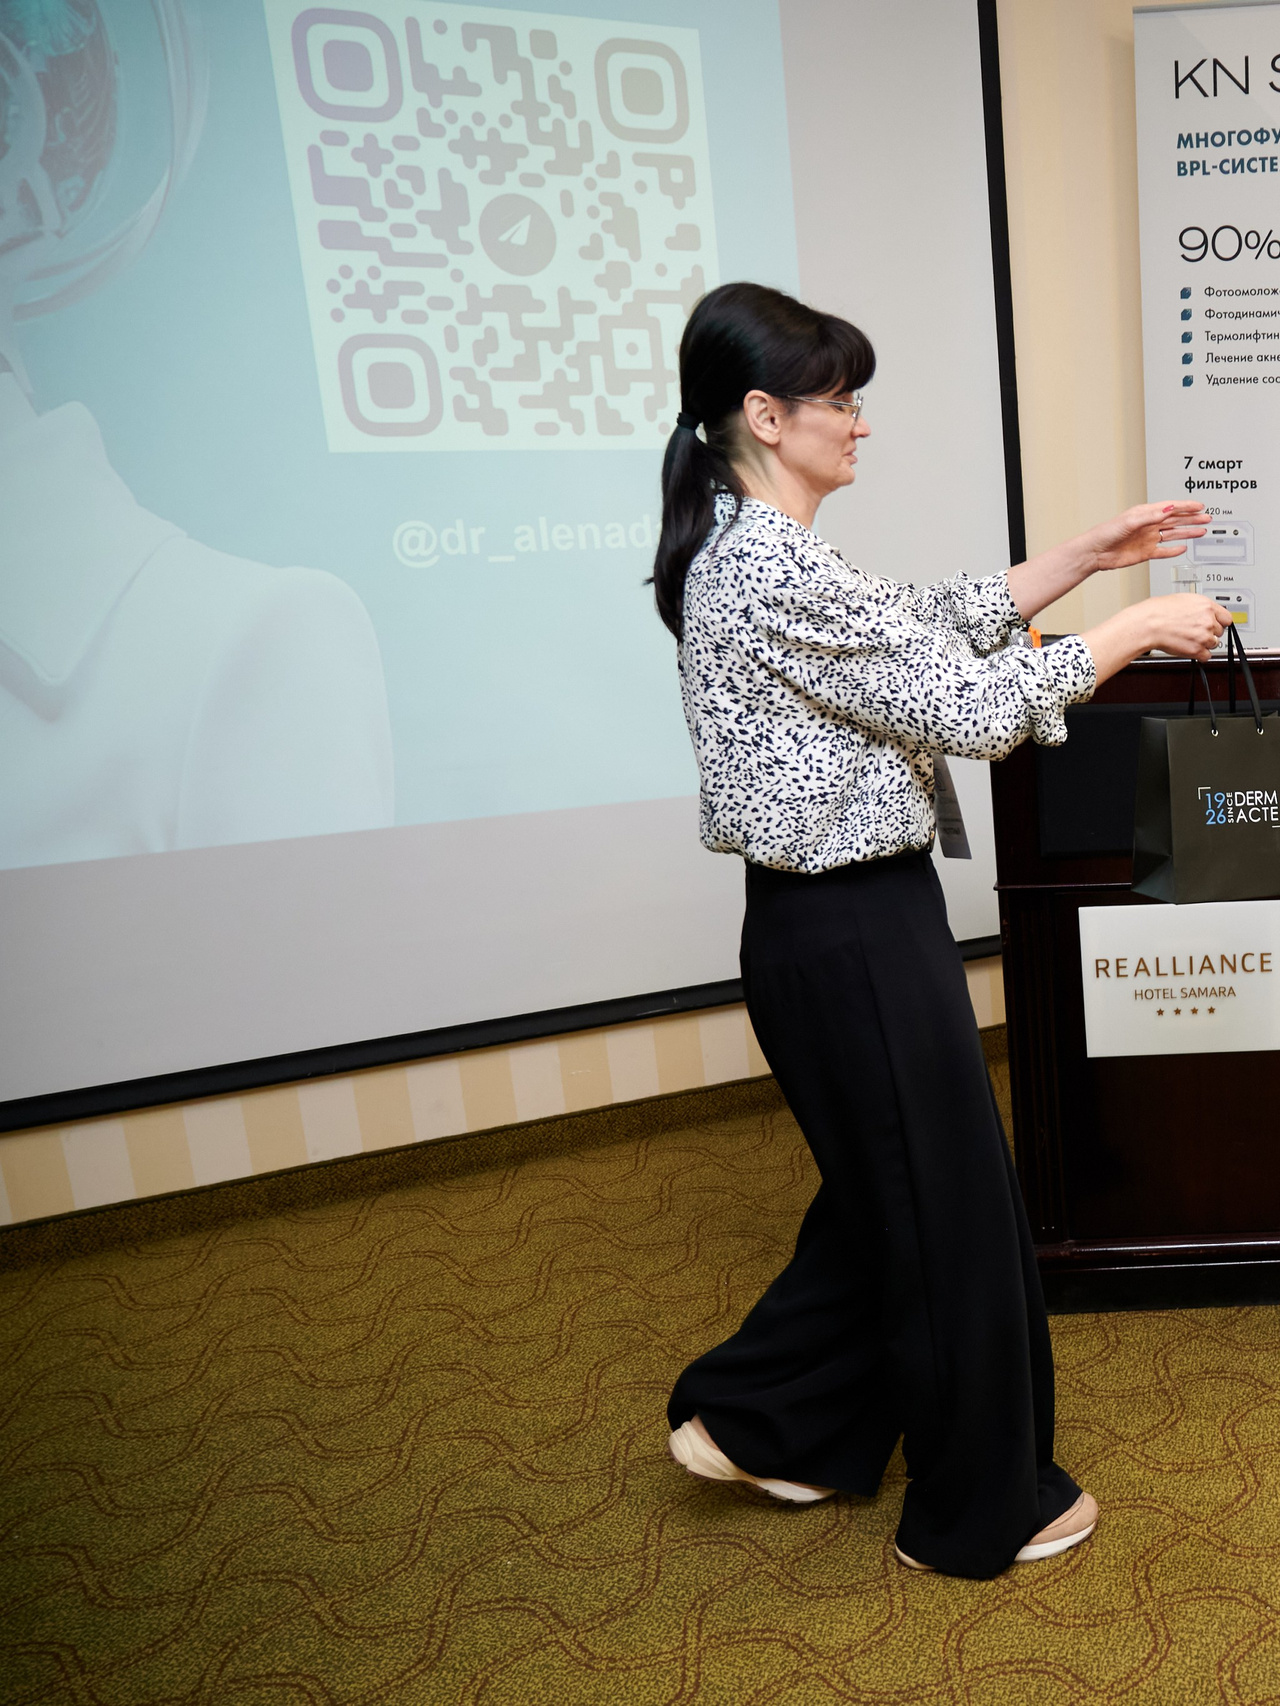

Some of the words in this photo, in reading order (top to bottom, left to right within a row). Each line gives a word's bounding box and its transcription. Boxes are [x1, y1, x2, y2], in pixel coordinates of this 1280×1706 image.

[1174, 55, 1249, 99] KN
[1205, 352, 1253, 363] Лечение
[1206, 374, 1259, 386] Удаление
[1184, 456, 1193, 469] 7
[1198, 460, 1243, 473] смарт
[1185, 476, 1257, 493] фильтров
[1205, 507, 1220, 515] 420
[392, 515, 660, 568] @dr_alenad
[1205, 792, 1226, 809] 19
[1234, 789, 1278, 807] DERM
[1225, 791, 1235, 824] SINCE
[1235, 806, 1279, 824] ACTE
[1205, 808, 1227, 825] 26
[1095, 953, 1273, 978] REALLIANCE
[1134, 987, 1177, 1001] HOTEL
[1180, 985, 1237, 999] SAMARA
